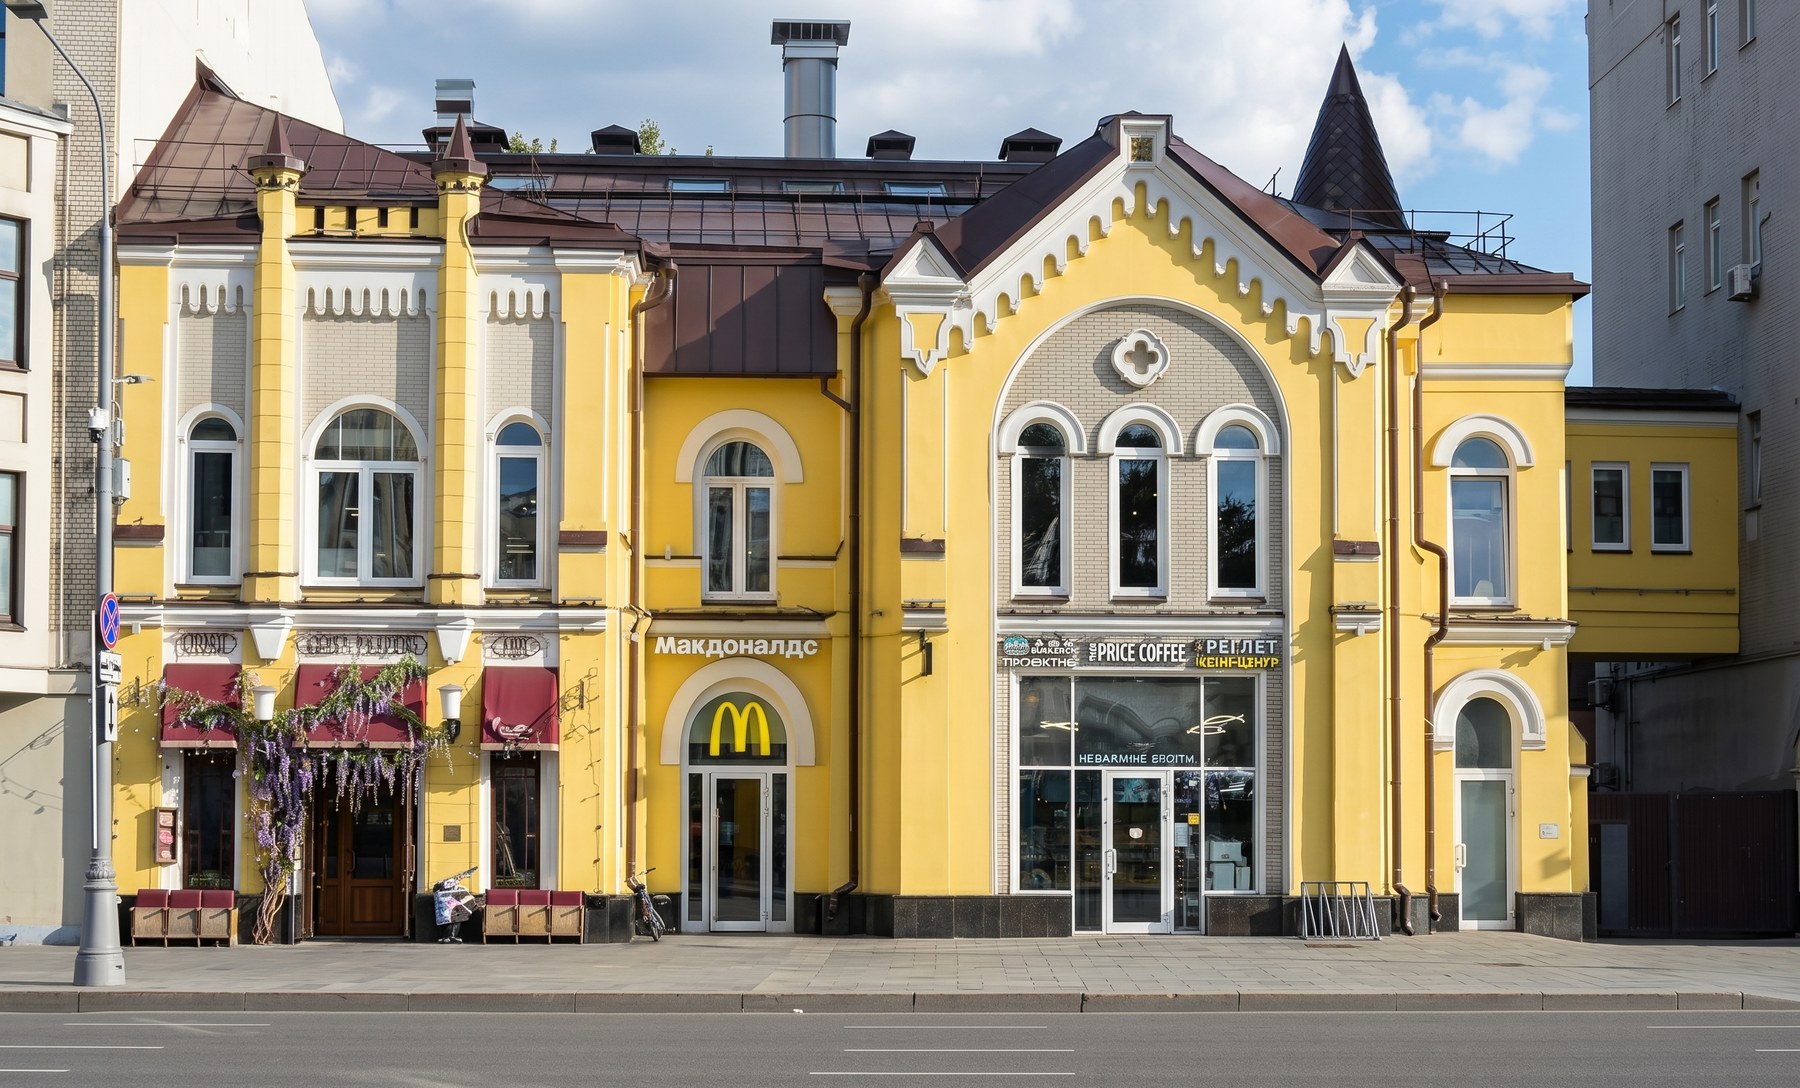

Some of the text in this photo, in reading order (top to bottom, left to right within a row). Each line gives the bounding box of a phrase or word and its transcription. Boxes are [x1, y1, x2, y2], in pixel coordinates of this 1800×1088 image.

[654, 636, 818, 659] Макдоналдс
[1097, 642, 1136, 662] PRICE
[1138, 643, 1187, 662] COFFEE
